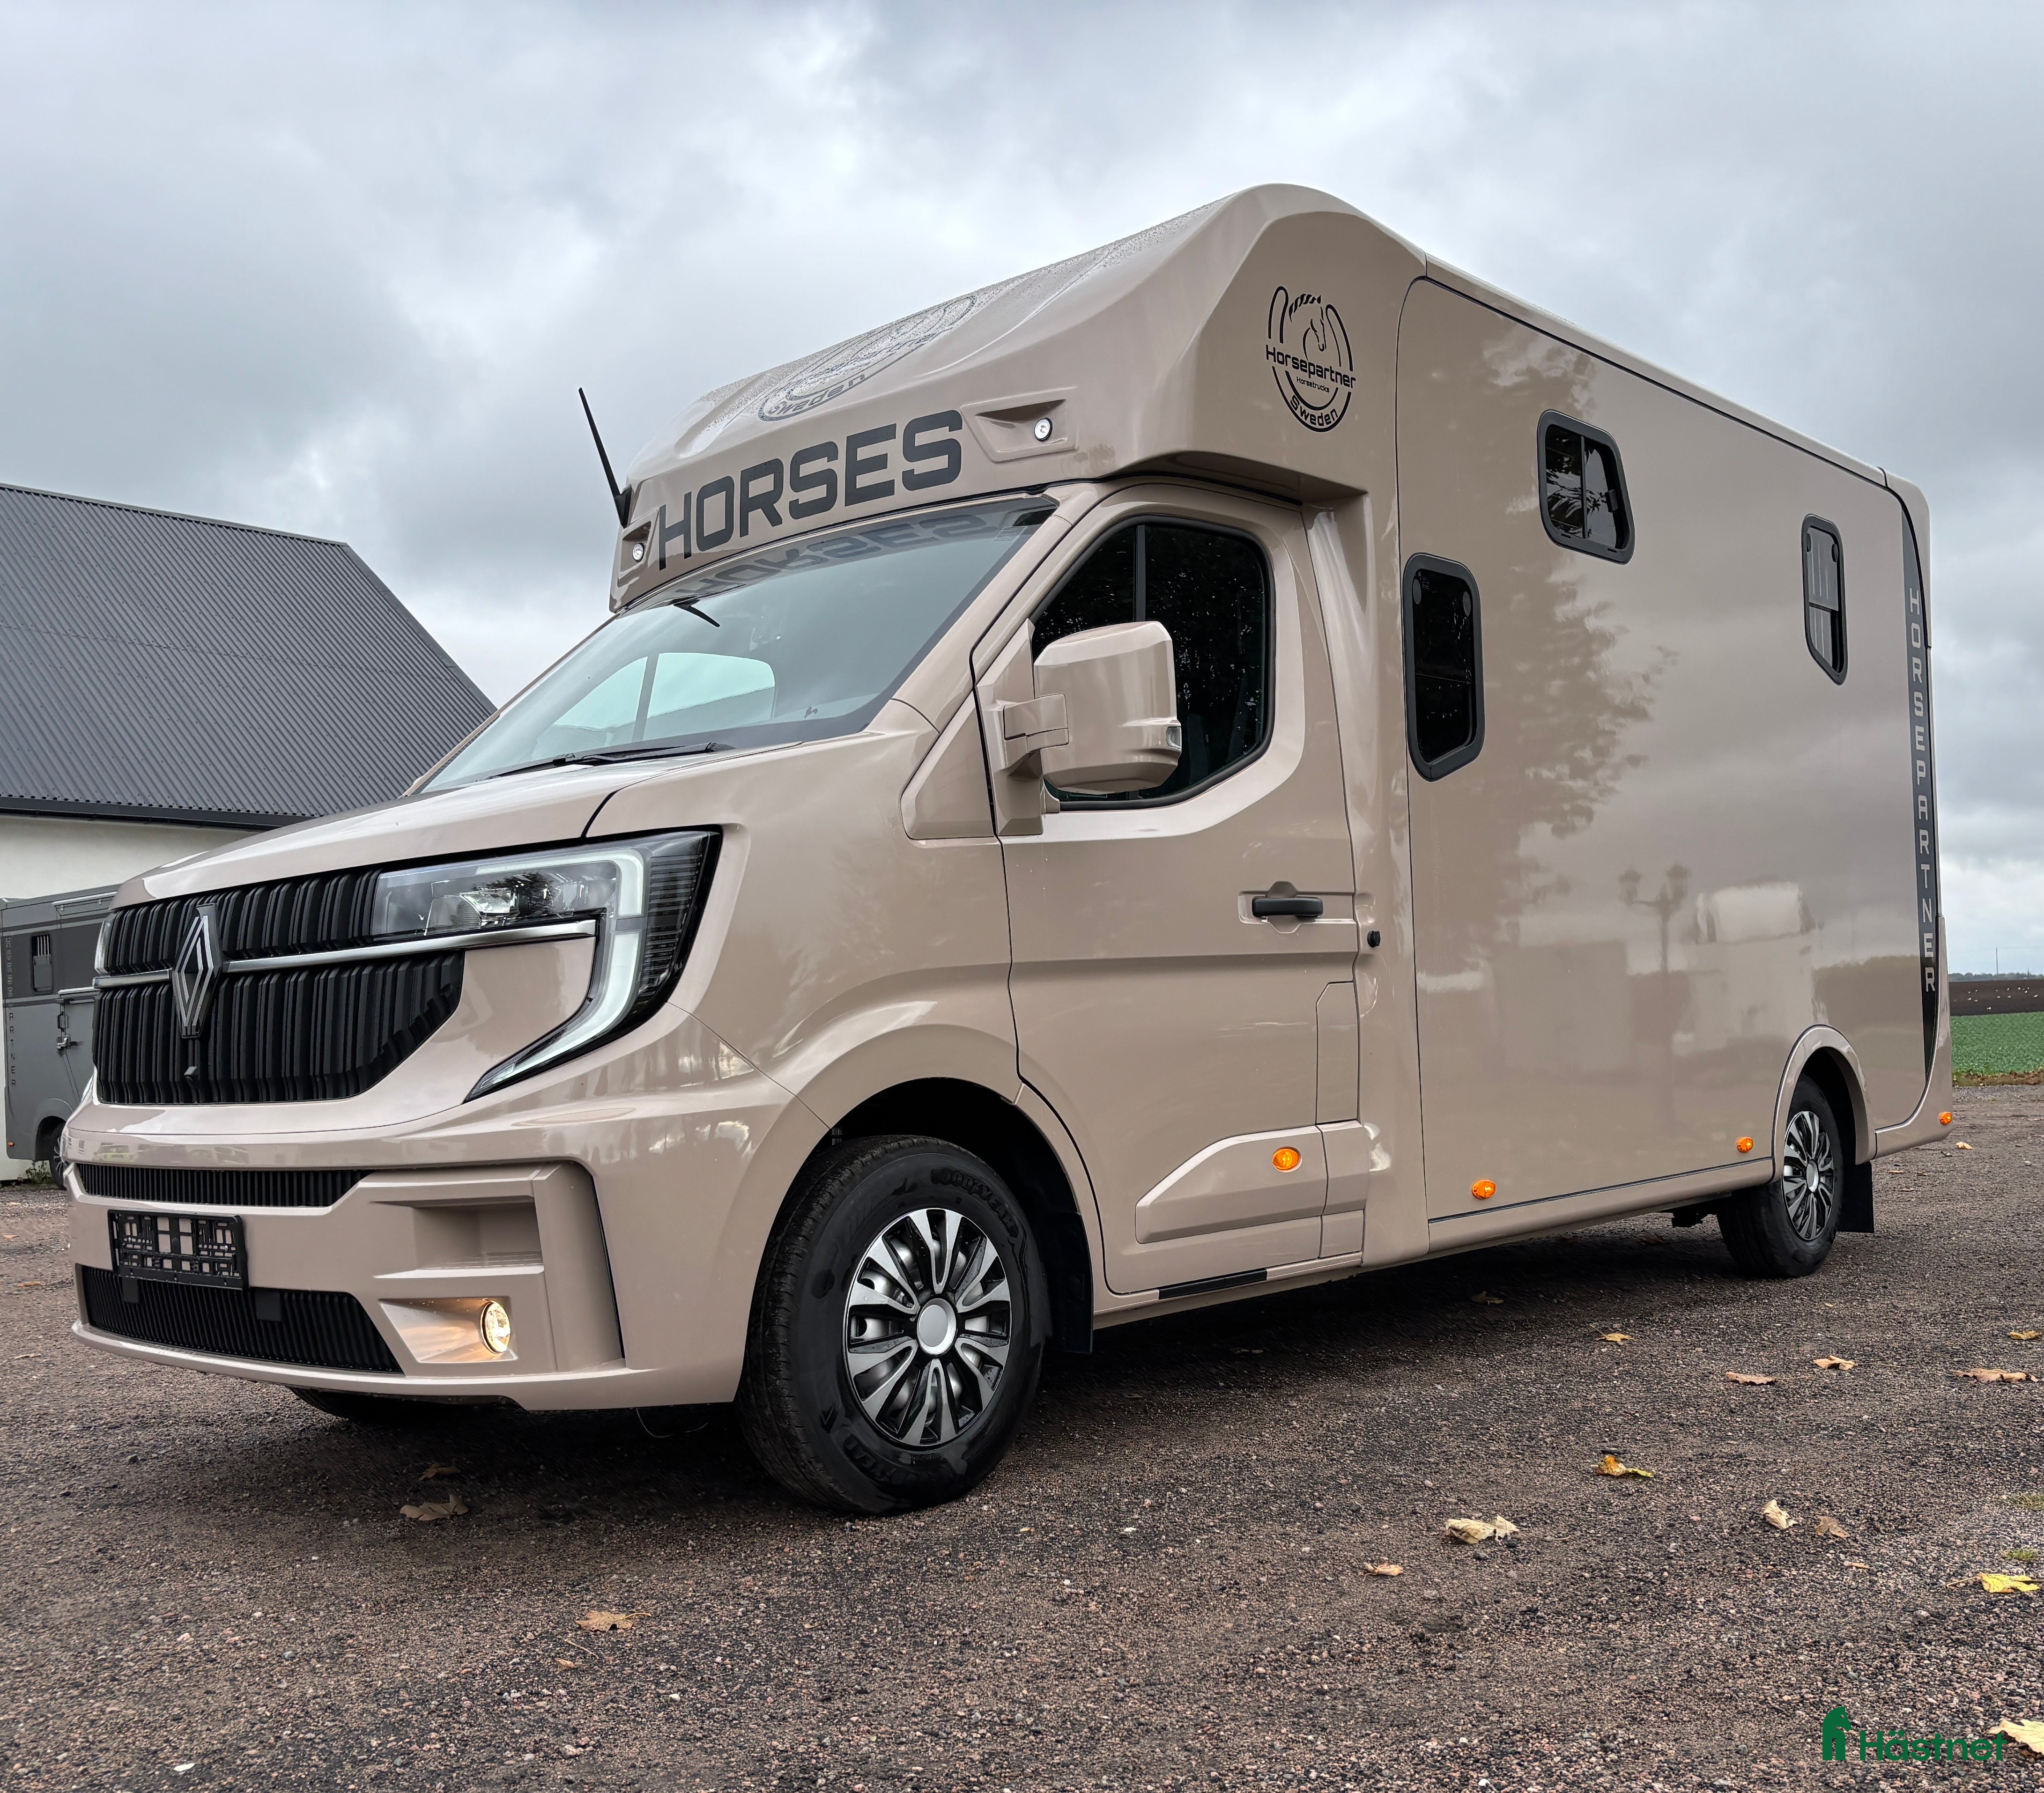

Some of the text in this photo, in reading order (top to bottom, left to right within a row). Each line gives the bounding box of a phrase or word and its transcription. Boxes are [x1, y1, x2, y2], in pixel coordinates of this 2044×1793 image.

[1266, 344, 1356, 388] Horsepartner
[1296, 376, 1330, 392] Horsetrucks
[1290, 395, 1338, 426] Sweden
[659, 410, 963, 571] HORSES
[1910, 587, 1935, 992] HORSEPARTNER
